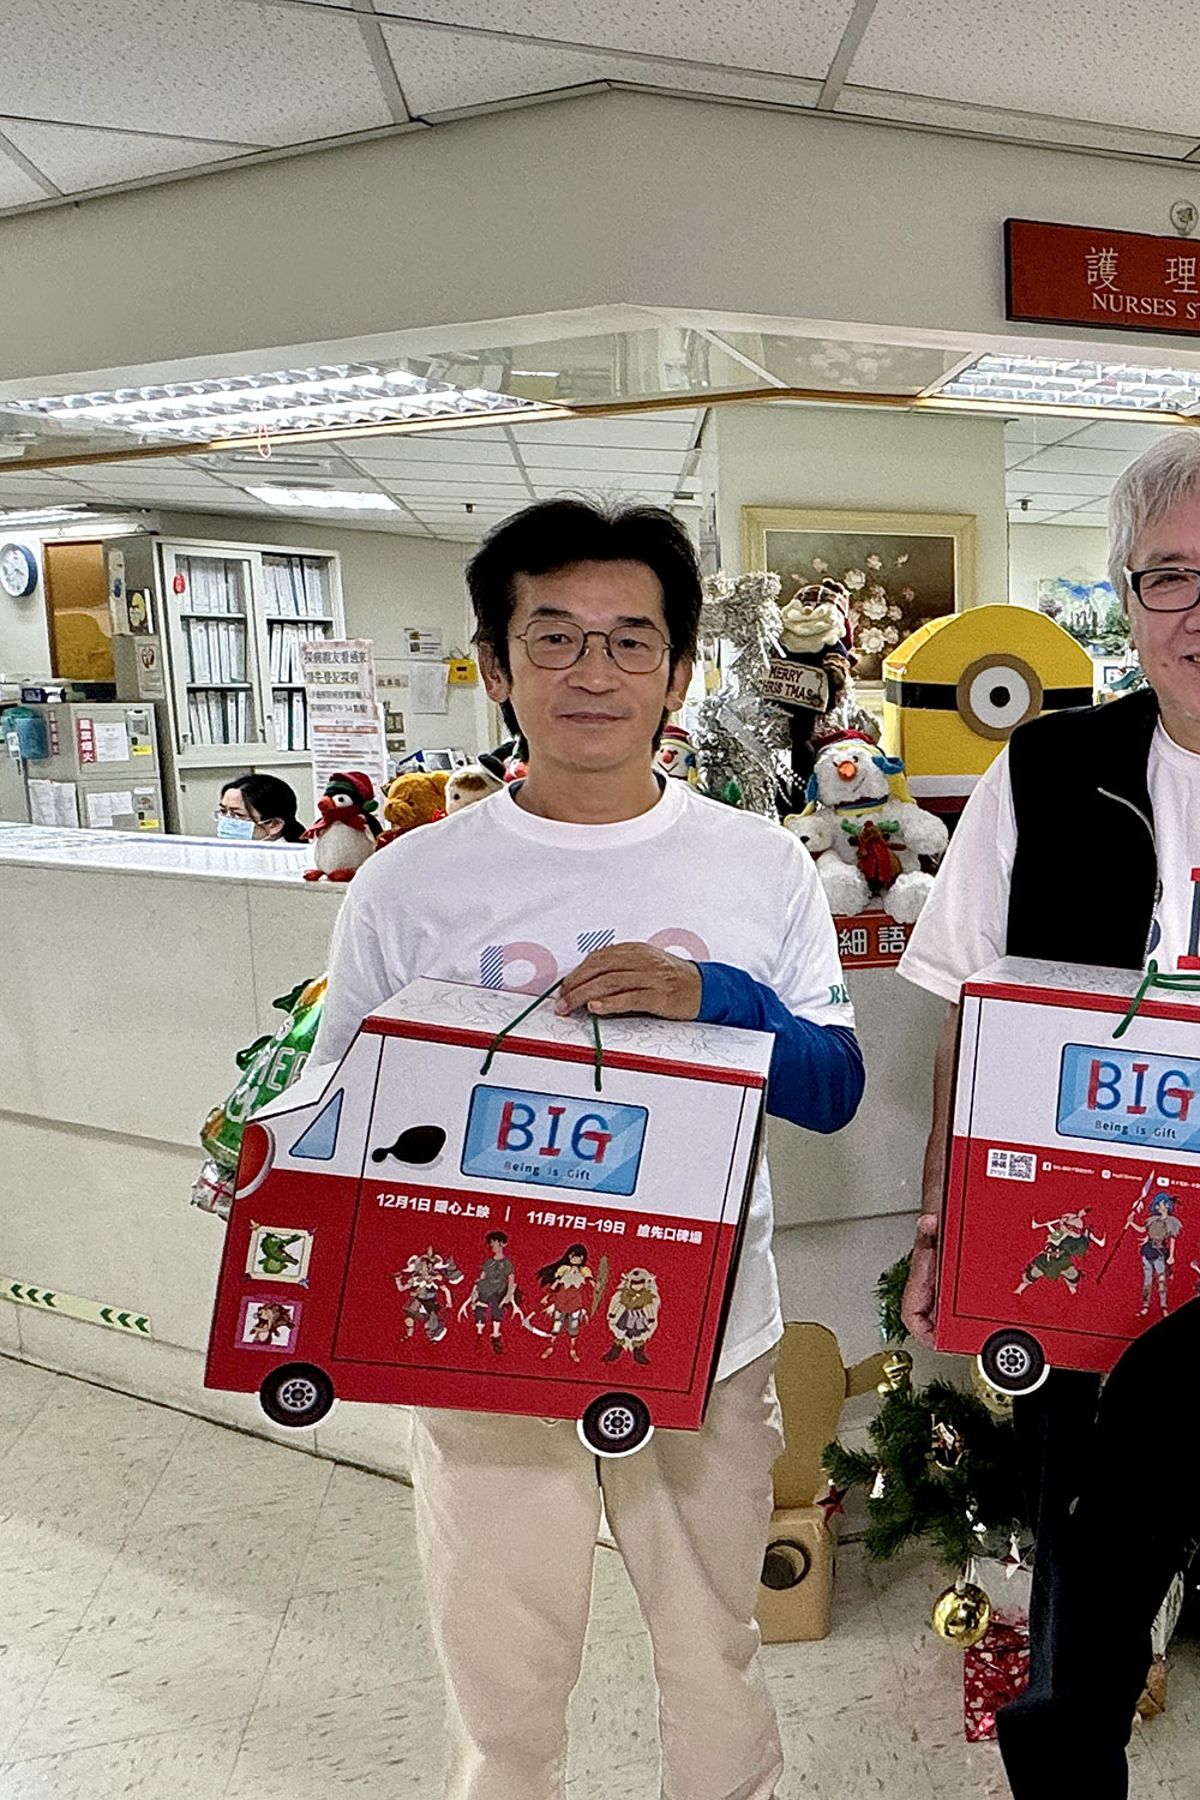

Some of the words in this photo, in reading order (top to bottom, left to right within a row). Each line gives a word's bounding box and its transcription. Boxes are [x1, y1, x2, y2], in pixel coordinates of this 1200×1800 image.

[1091, 292, 1177, 318] NURSES
[769, 665, 804, 683] MERRY
[838, 925, 906, 956] 細語
[1086, 1059, 1195, 1122] BIG
[496, 1100, 613, 1164] BIG
[1095, 1120, 1129, 1135] Being
[1136, 1124, 1147, 1135] is
[1152, 1126, 1178, 1139] Gift
[504, 1160, 541, 1177] Being
[548, 1165, 559, 1177] is
[567, 1169, 591, 1181] Gift
[376, 1193, 432, 1212] 12月1日
[434, 1199, 491, 1219] 暖心上映
[526, 1210, 626, 1236] 11月17日-19日
